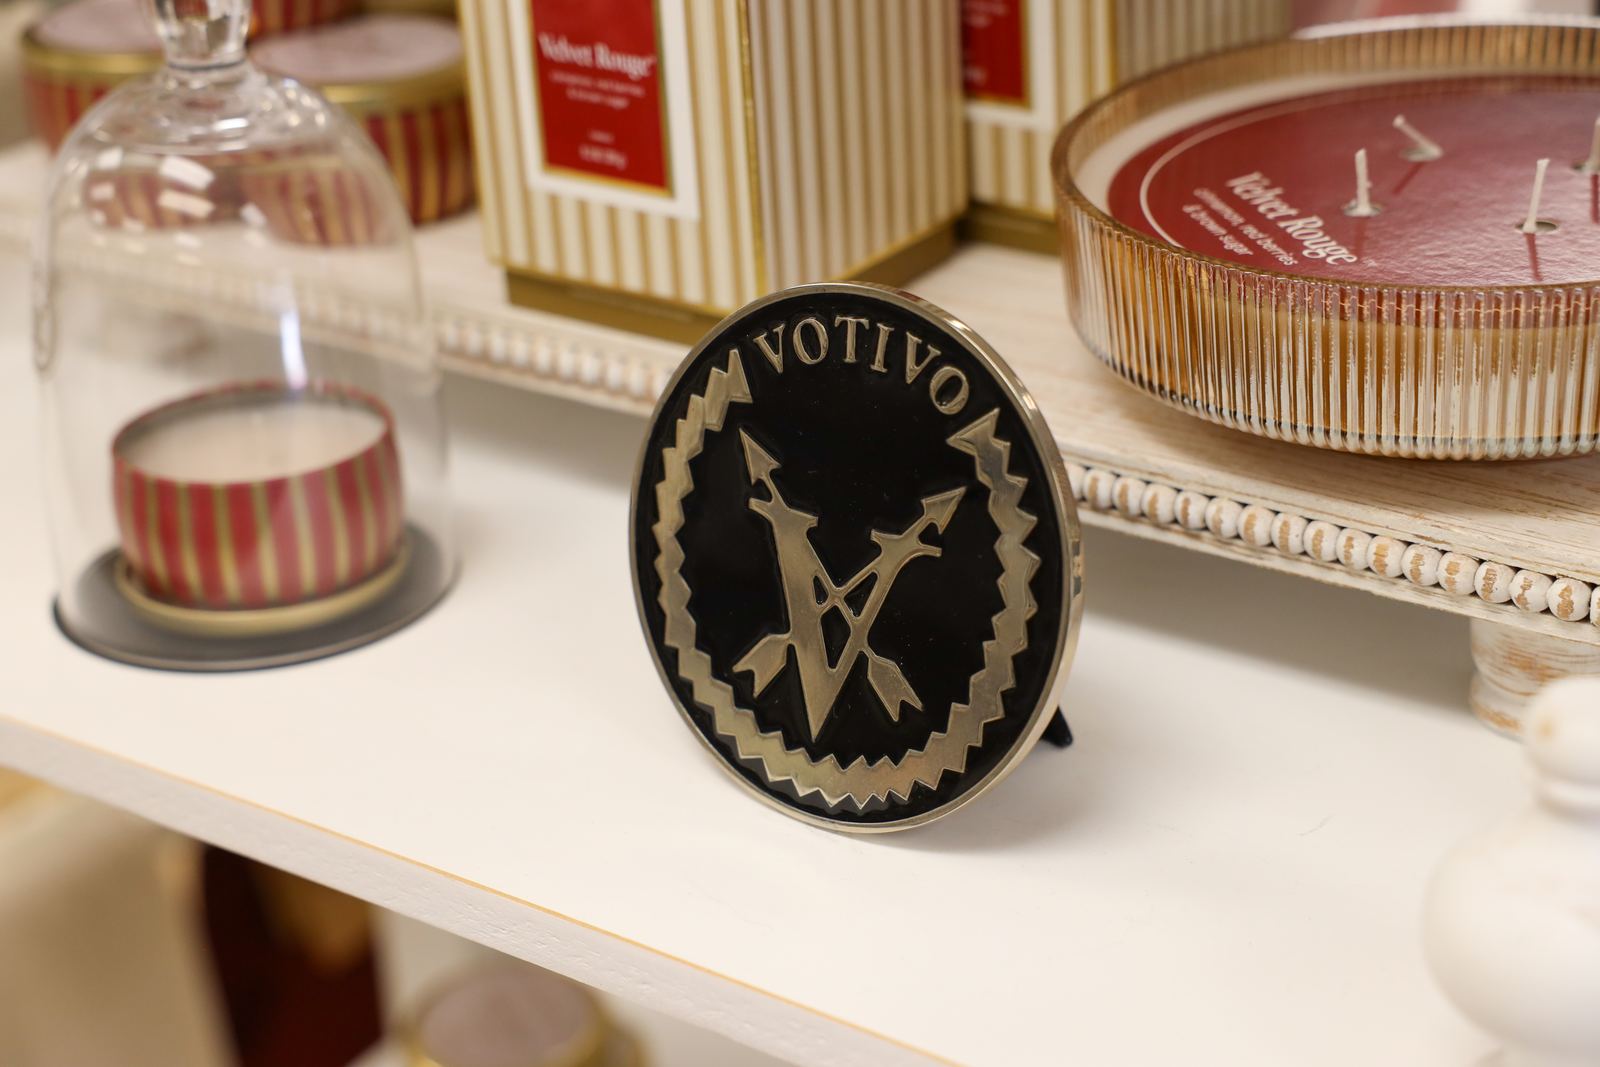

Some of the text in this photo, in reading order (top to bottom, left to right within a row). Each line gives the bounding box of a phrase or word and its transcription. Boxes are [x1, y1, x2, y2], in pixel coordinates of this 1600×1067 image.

[1190, 208, 1227, 236] brown
[1219, 234, 1254, 256] sugar
[1226, 171, 1358, 265] Velvet Rouge
[1240, 224, 1268, 240] red
[1256, 237, 1298, 265] berries
[752, 315, 970, 415] VOTIVO
